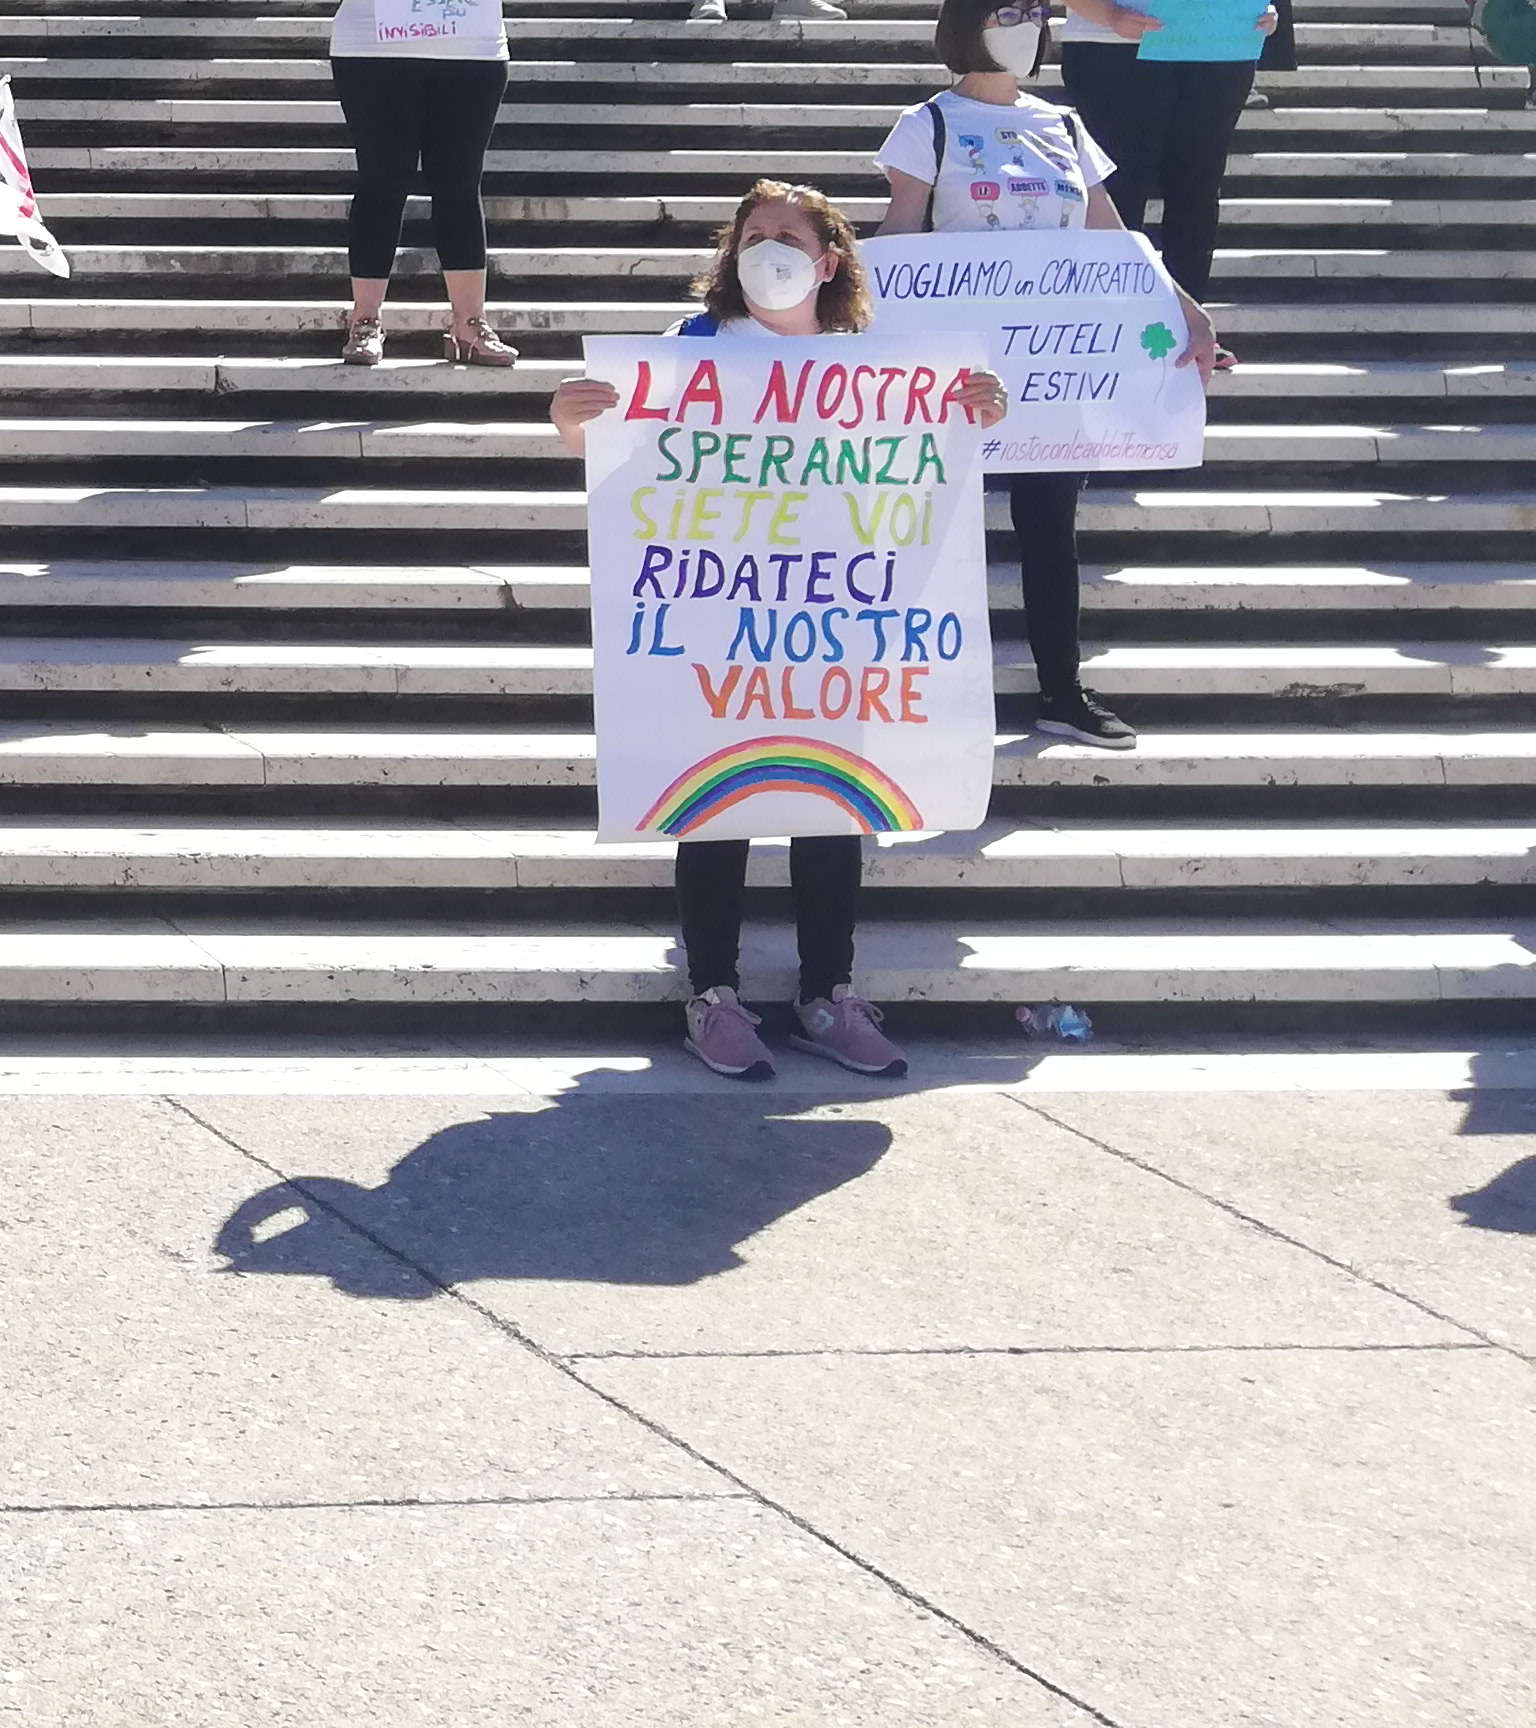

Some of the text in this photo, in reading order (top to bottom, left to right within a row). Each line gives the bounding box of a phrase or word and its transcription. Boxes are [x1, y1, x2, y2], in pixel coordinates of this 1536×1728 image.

[874, 258, 1013, 300] VOGLIAMO
[1038, 257, 1156, 296] CONTRATTO
[1001, 323, 1124, 357] TUTELI
[624, 358, 976, 430] LA NOSTRA
[1020, 372, 1120, 403] ESTIVI
[655, 427, 948, 486] SPERANZA
[630, 486, 933, 547] SIETE VOI
[726, 606, 963, 663] NOSTRO
[691, 663, 931, 723] VALORE
